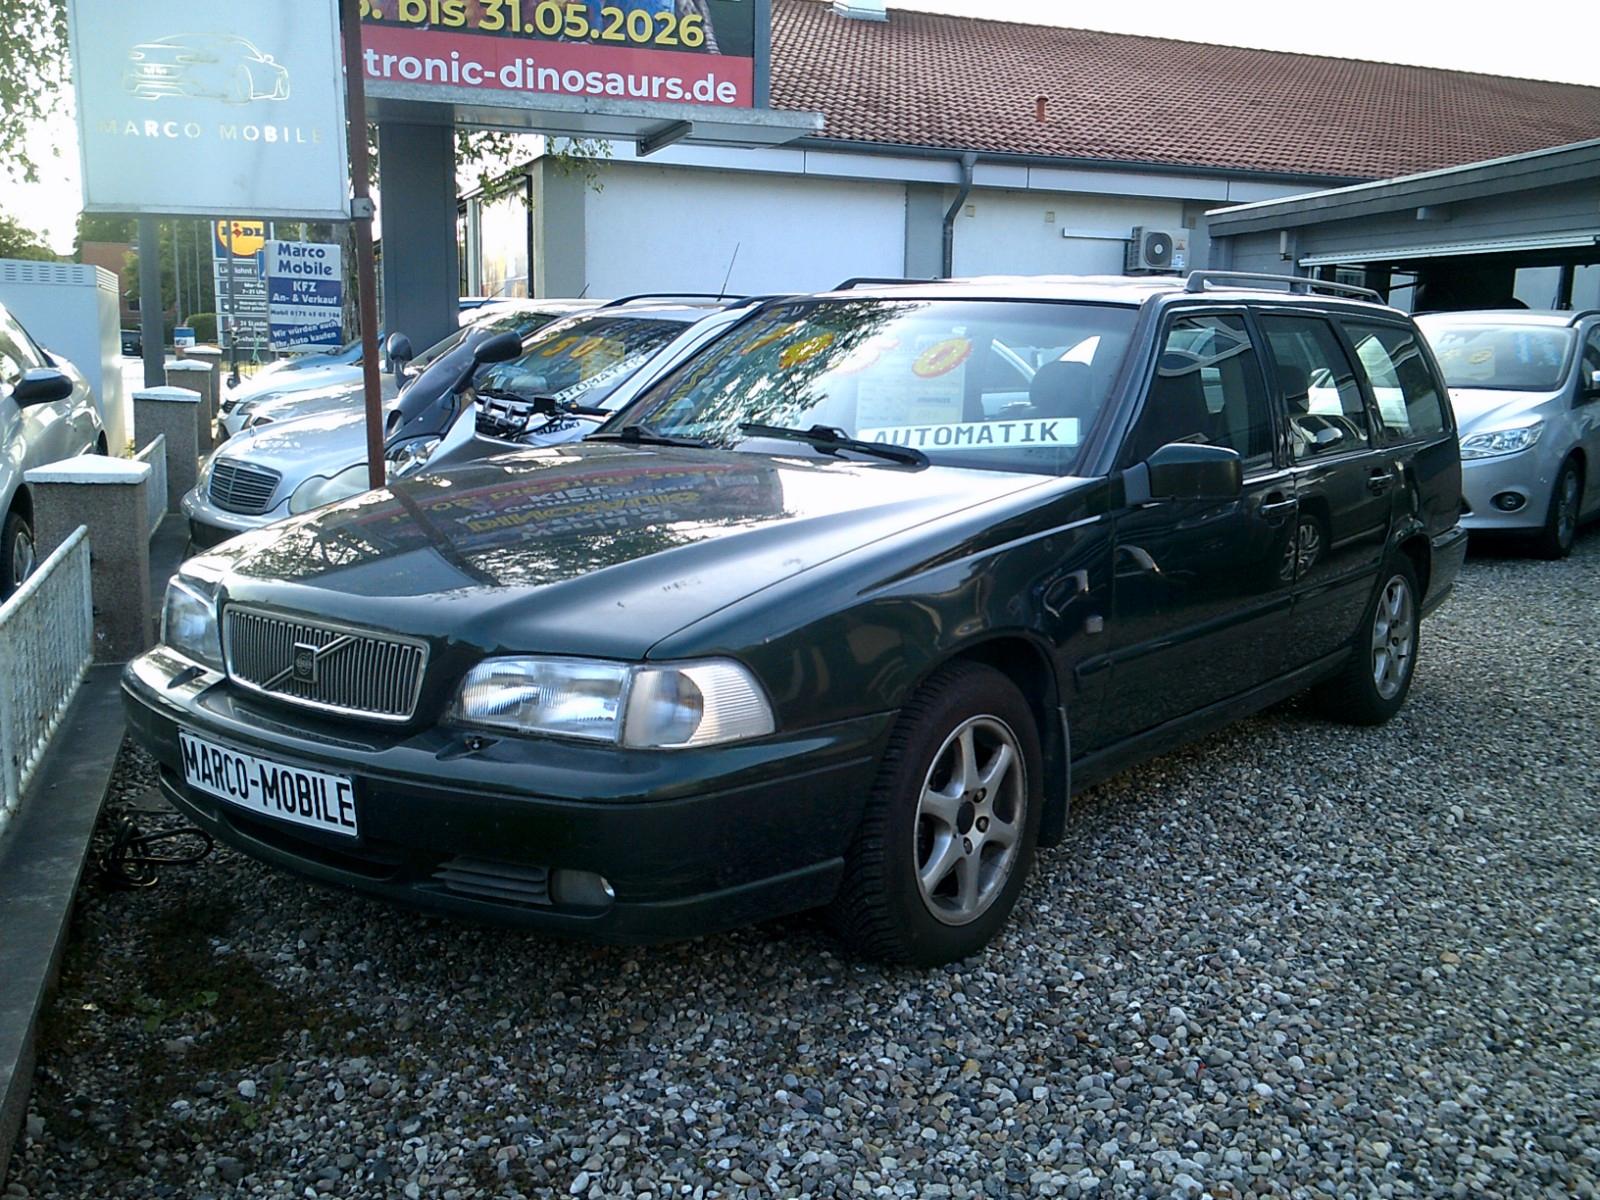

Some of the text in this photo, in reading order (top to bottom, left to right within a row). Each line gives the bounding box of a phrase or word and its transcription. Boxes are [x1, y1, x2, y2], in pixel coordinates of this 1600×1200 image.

[399, 0, 466, 27] bis
[479, 0, 705, 48] 31.05.2026
[343, 48, 737, 103] tronic-dinosaurs.de
[97, 119, 321, 144] MARCO MOBILE
[277, 243, 325, 258] Marco
[278, 260, 332, 275] Mobile
[293, 281, 317, 292] KFZ
[272, 293, 337, 304] An- & Verkauf
[290, 337, 309, 345] Auto
[558, 356, 643, 401] UTOMATIK
[535, 421, 581, 436] SUZUKI
[874, 421, 1059, 447] AUTOMATIK
[181, 737, 355, 828] MARCO-MOBILE
